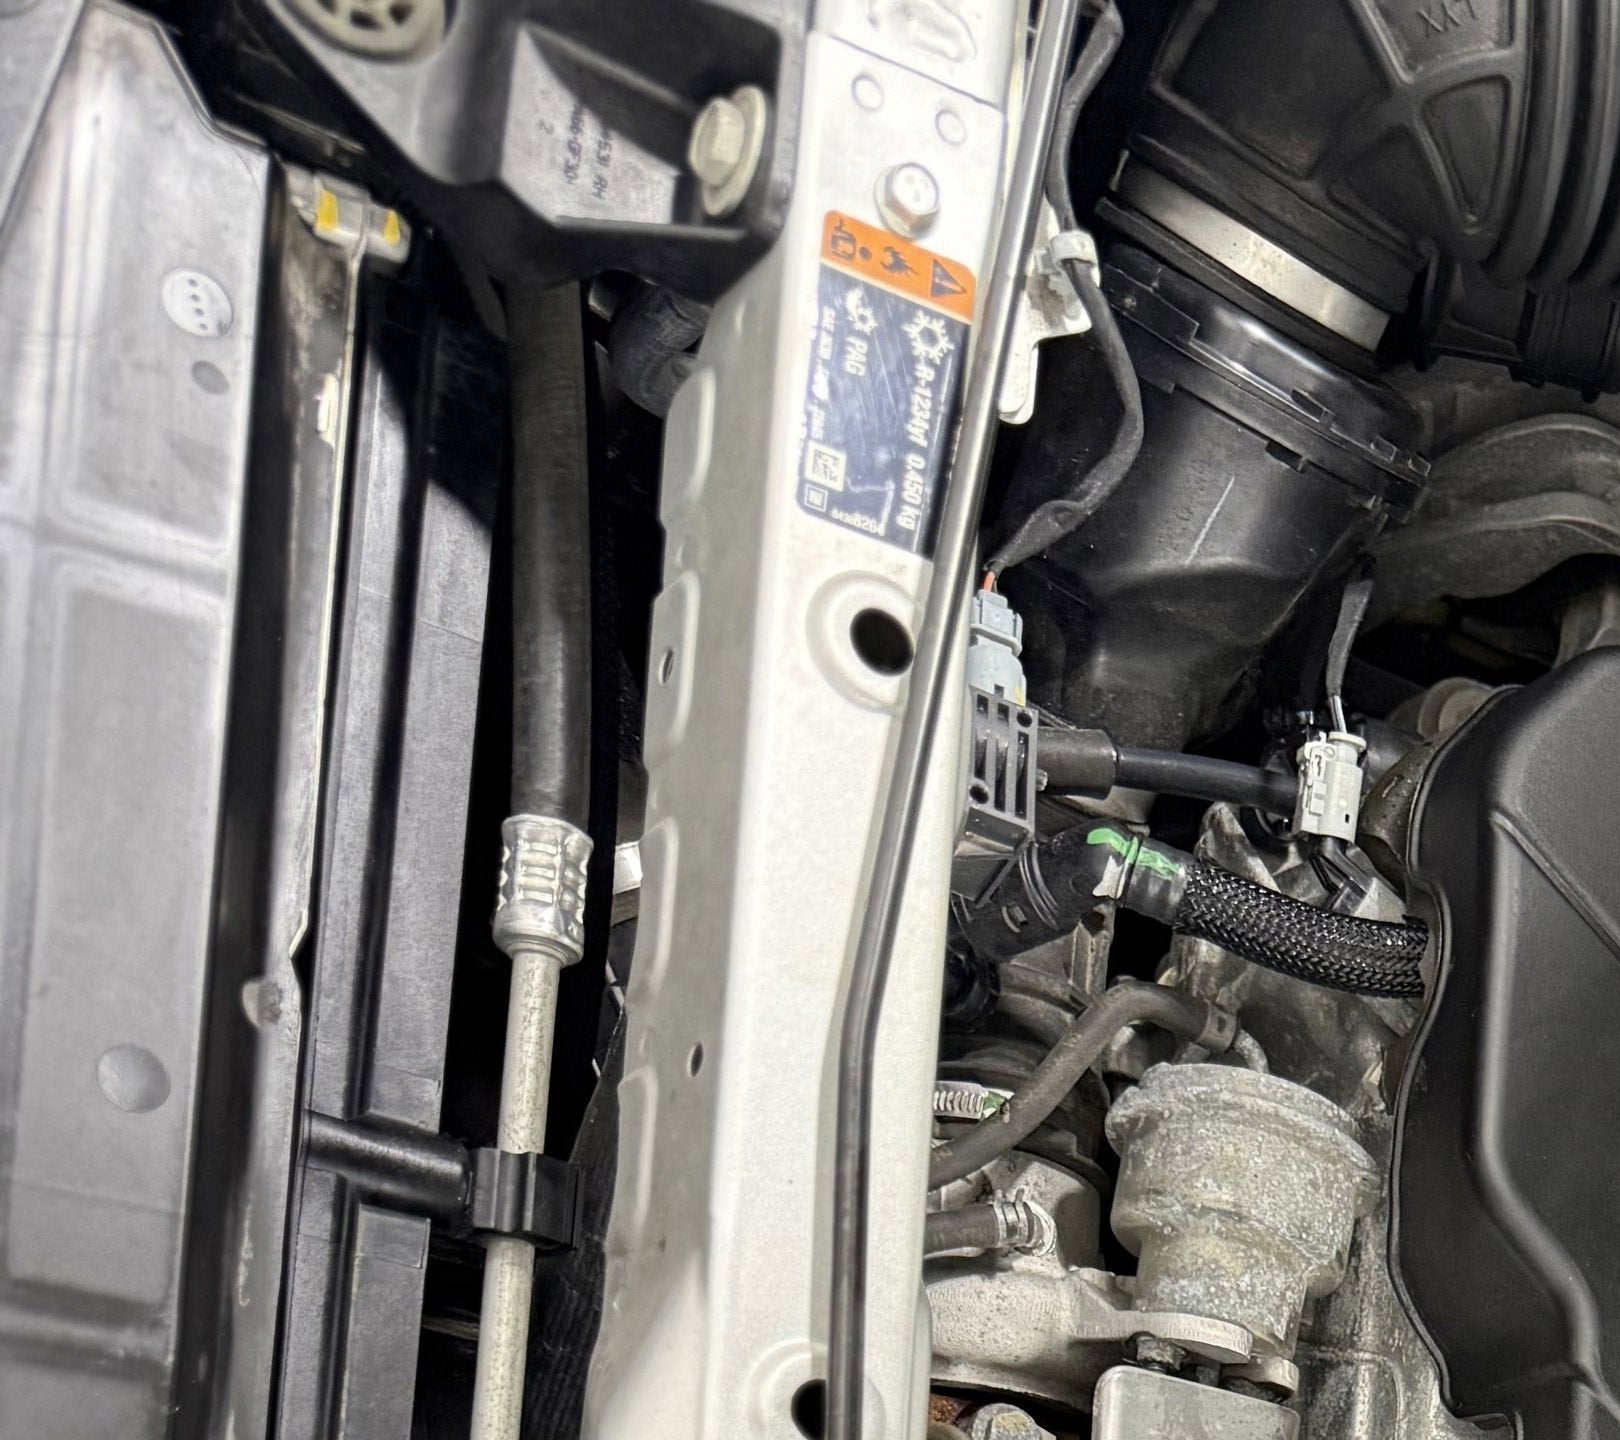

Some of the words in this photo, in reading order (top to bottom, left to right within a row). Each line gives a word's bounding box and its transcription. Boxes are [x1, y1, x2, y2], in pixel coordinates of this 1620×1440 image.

[844, 335, 868, 377] PAG
[905, 363, 935, 449] R-1234yf
[902, 454, 927, 503] 0.450
[895, 504, 920, 531] kg
